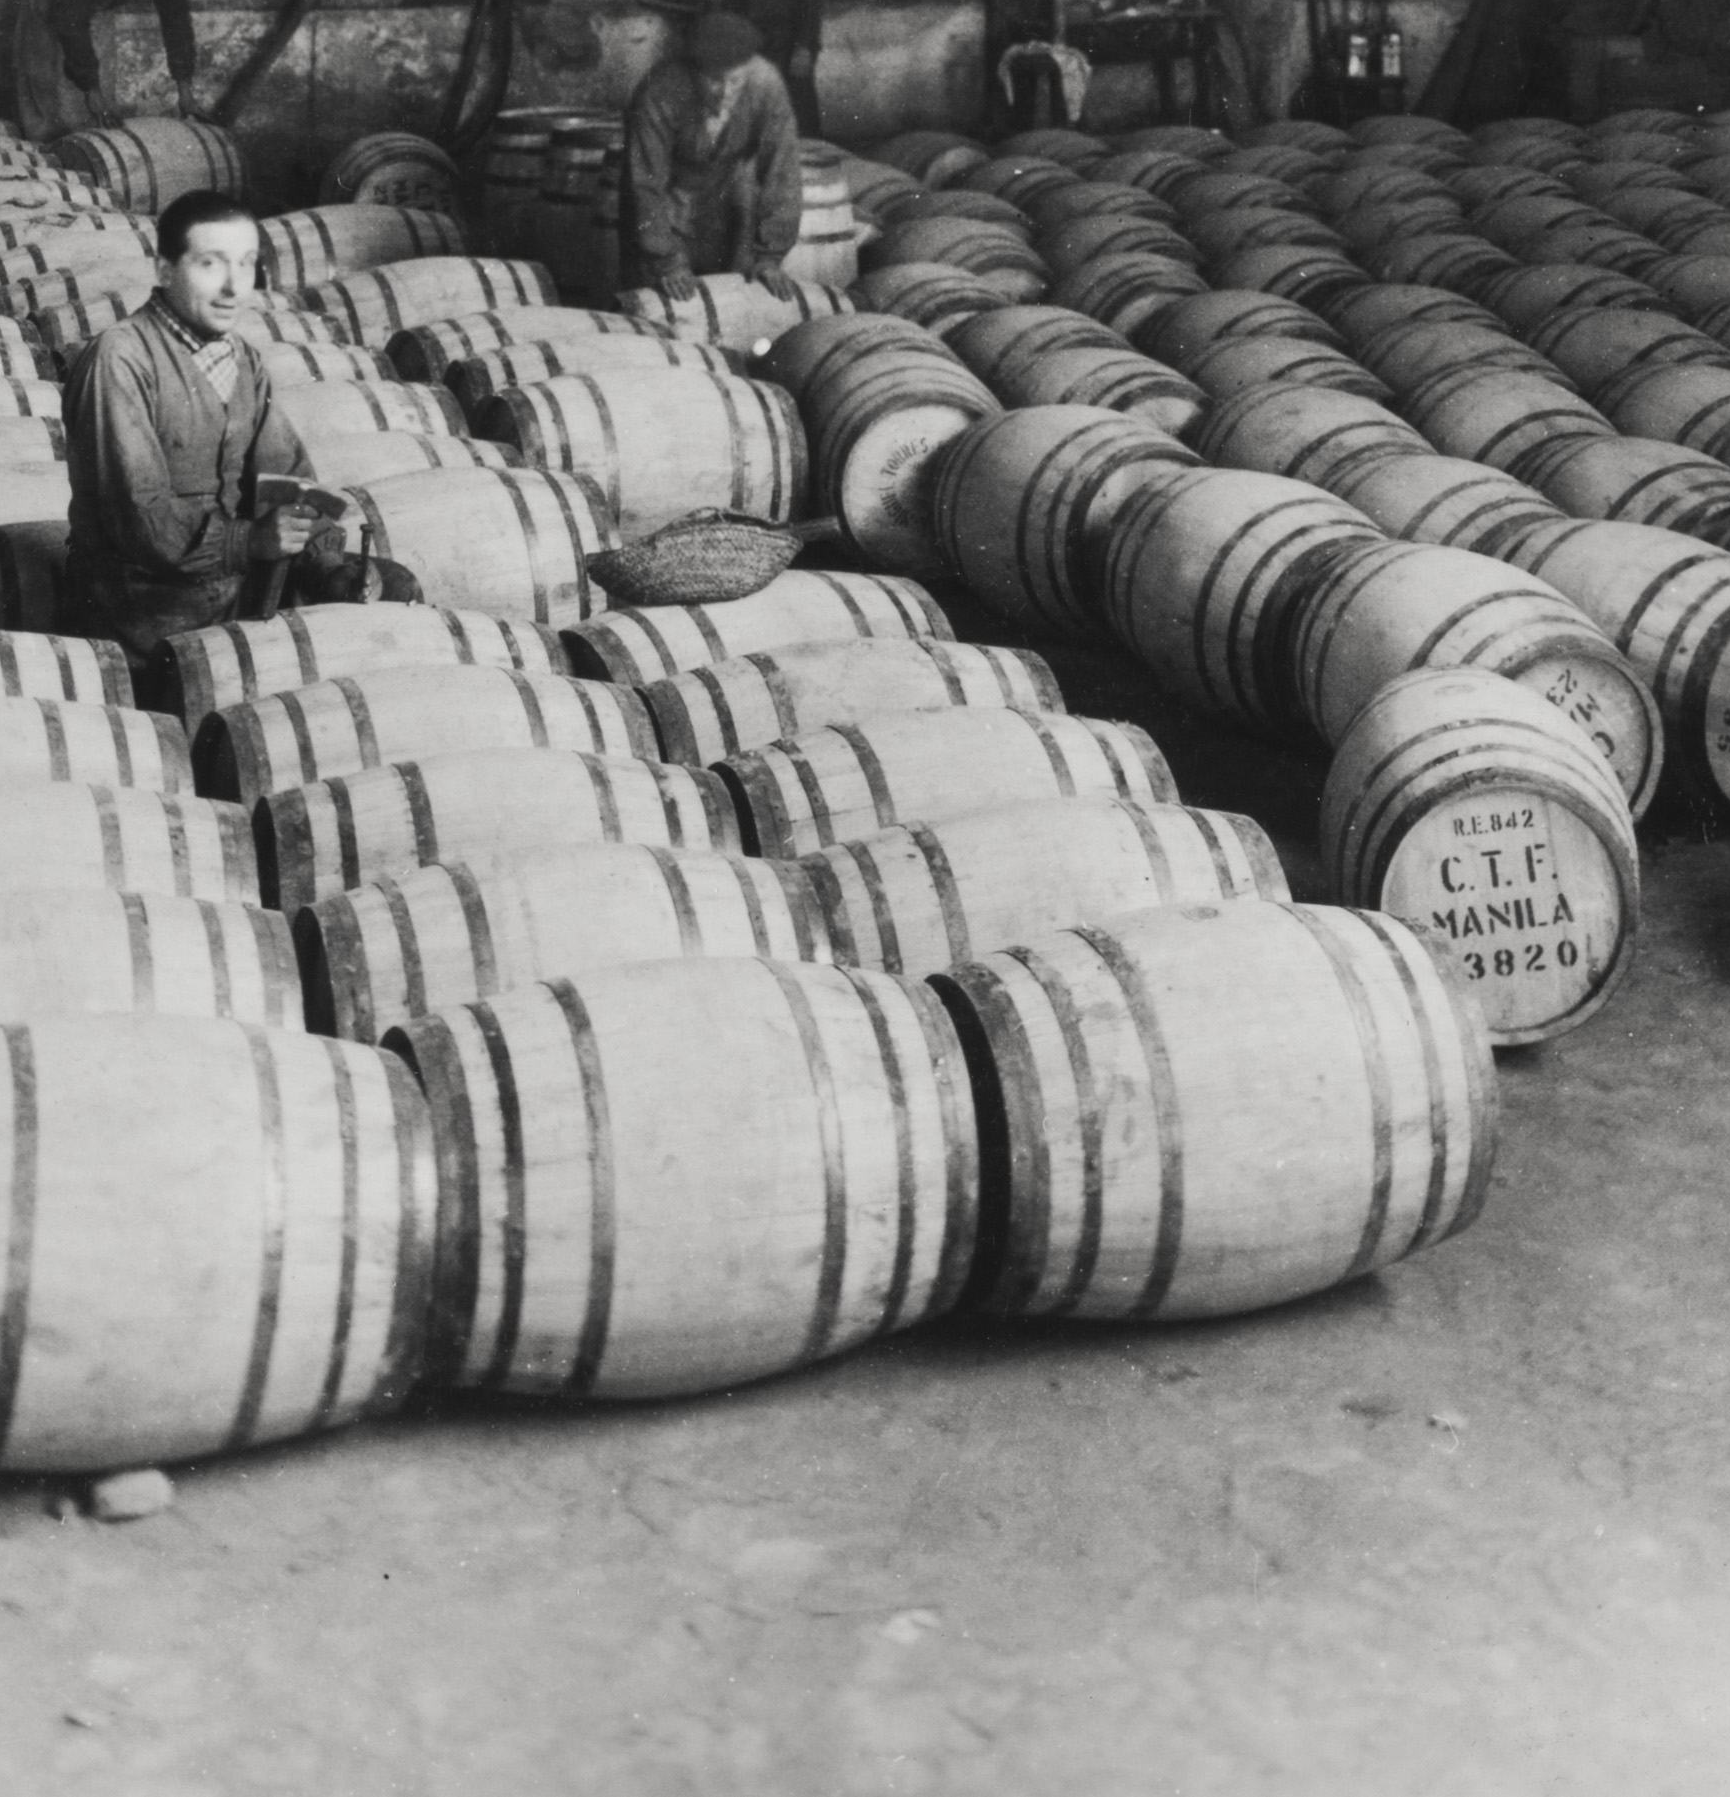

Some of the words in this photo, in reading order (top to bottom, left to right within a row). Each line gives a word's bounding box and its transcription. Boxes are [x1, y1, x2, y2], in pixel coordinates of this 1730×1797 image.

[1453, 809, 1535, 836] R.E.842
[1432, 893, 1575, 939] MANILA
[1464, 940, 1578, 980] 3820
